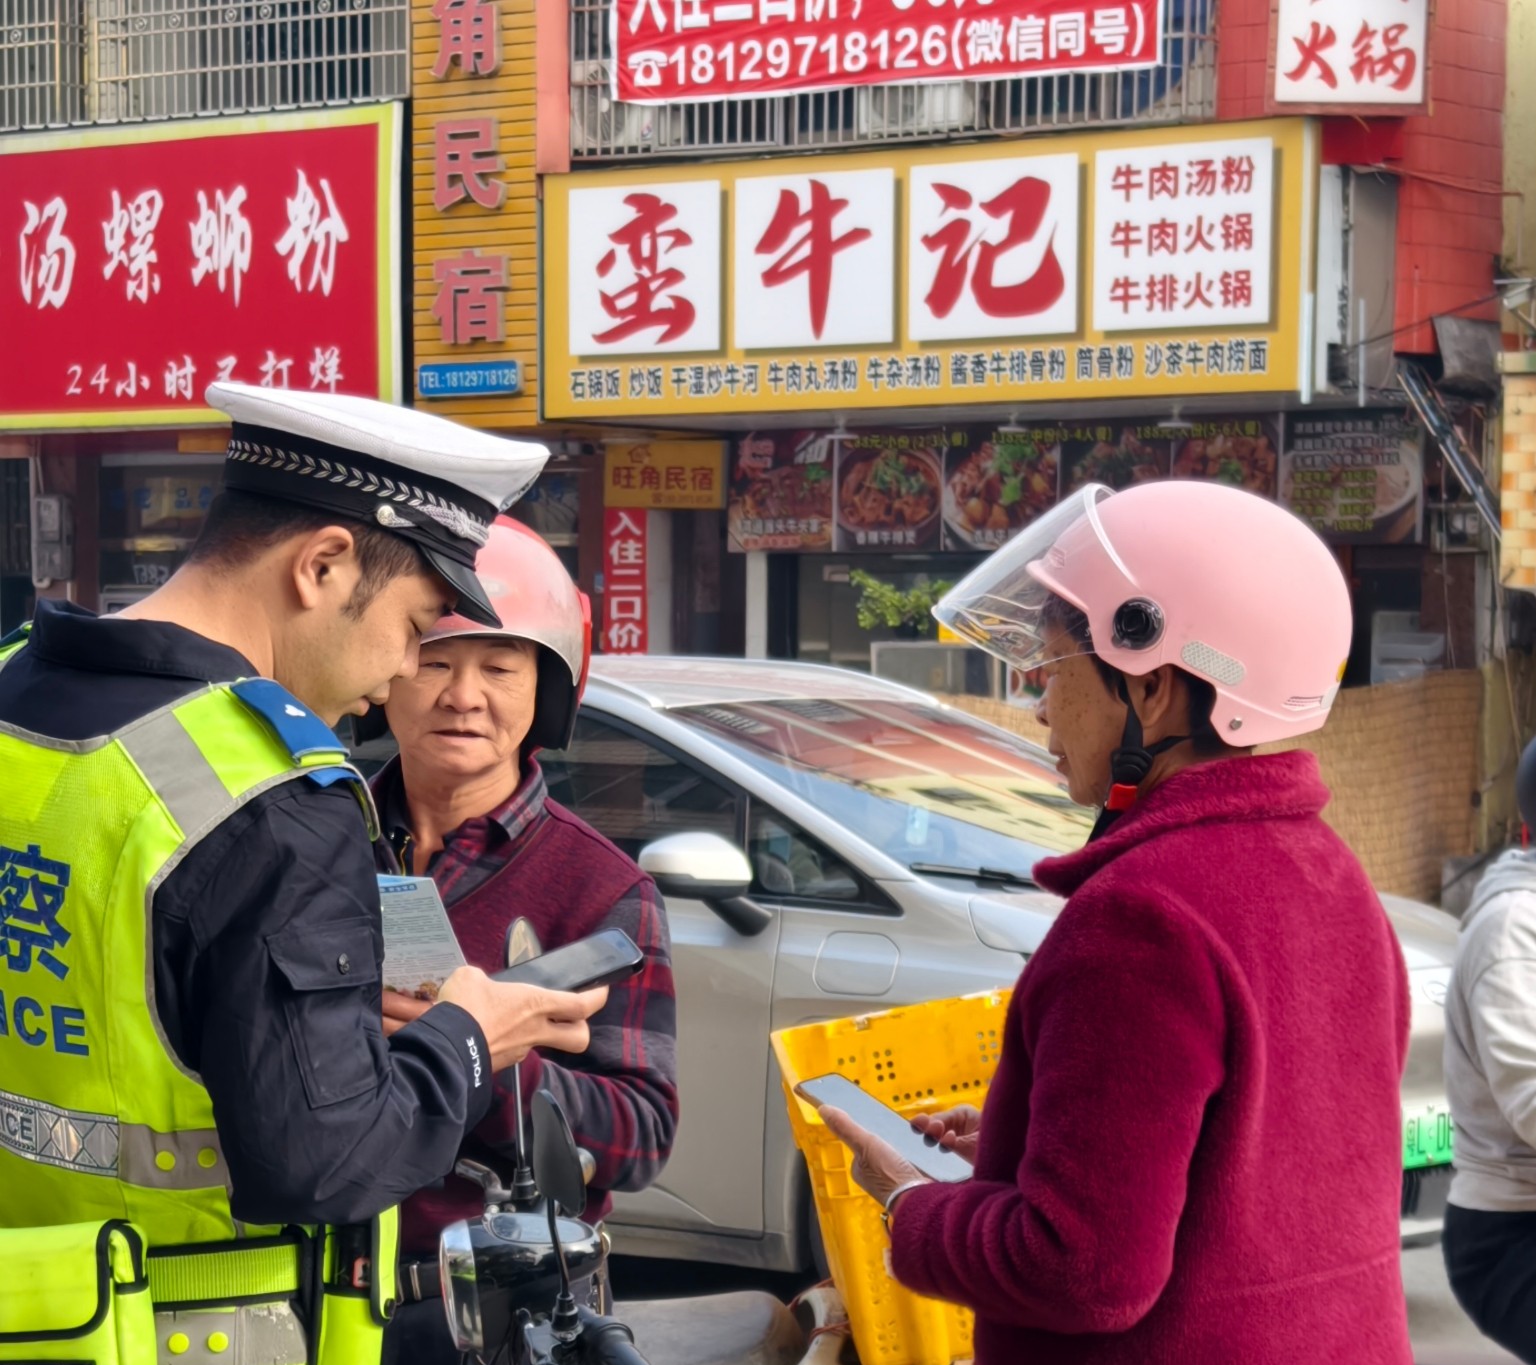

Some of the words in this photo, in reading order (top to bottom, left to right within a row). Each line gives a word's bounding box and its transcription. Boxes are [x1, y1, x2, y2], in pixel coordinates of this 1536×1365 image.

[669, 3, 1145, 86] 18129718126(微信同号)
[1284, 20, 1417, 92] 火锅
[1111, 155, 1255, 203] 牛肉汤粉
[591, 176, 1066, 345] 蛮牛记
[1110, 213, 1254, 259] 牛肉火锅
[1109, 269, 1253, 314] 牛排火锅
[570, 367, 621, 400] 石锅饭
[629, 366, 663, 398] 炒饭
[671, 363, 760, 397] 干湿炒牛河
[767, 358, 859, 393] 牛肉丸汤粉
[866, 355, 942, 390] 牛杂汤粉
[950, 349, 1067, 387] 酱香牛排骨粉
[1076, 345, 1135, 381] 筒骨粉
[1144, 339, 1269, 378] 沙茶牛肉捞面
[612, 466, 715, 491] 旺角民宿
[466, 1036, 482, 1087] POLICE
